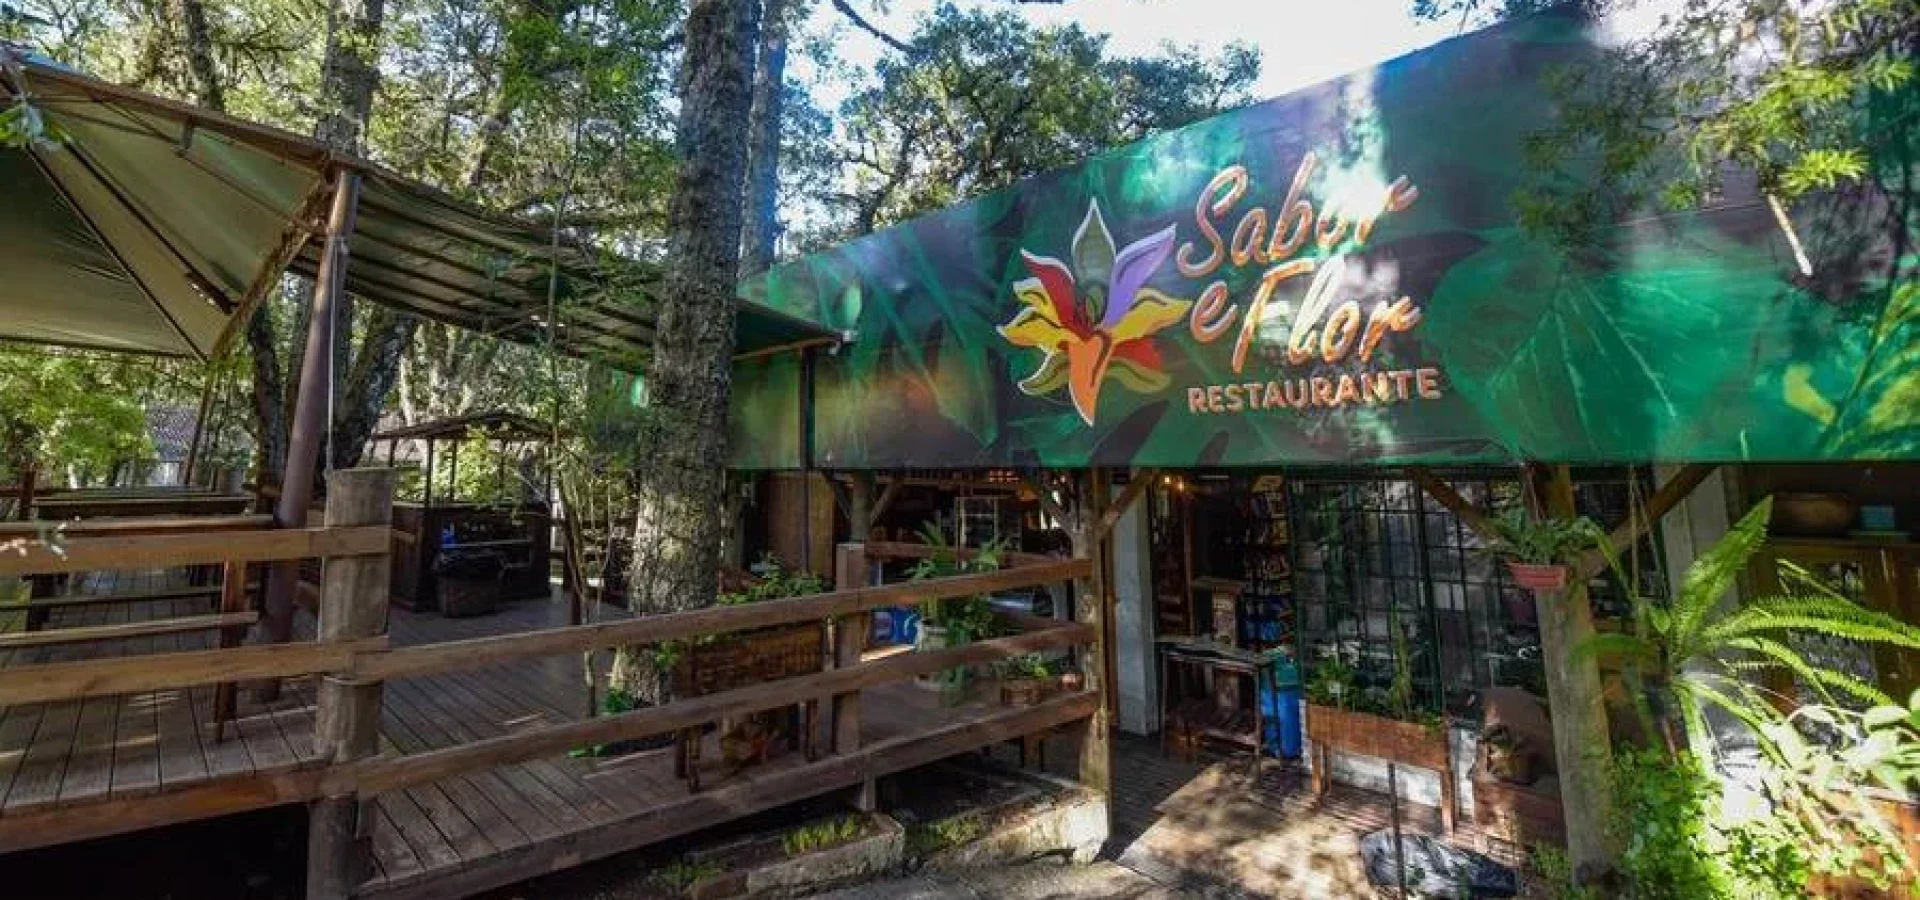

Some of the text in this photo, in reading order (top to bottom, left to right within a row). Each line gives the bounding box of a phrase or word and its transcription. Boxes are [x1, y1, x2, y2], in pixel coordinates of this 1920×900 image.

[1177, 152, 1419, 277] Sabor
[1190, 254, 1421, 373] e Flor
[1187, 368, 1442, 413] RESTAURANTE
